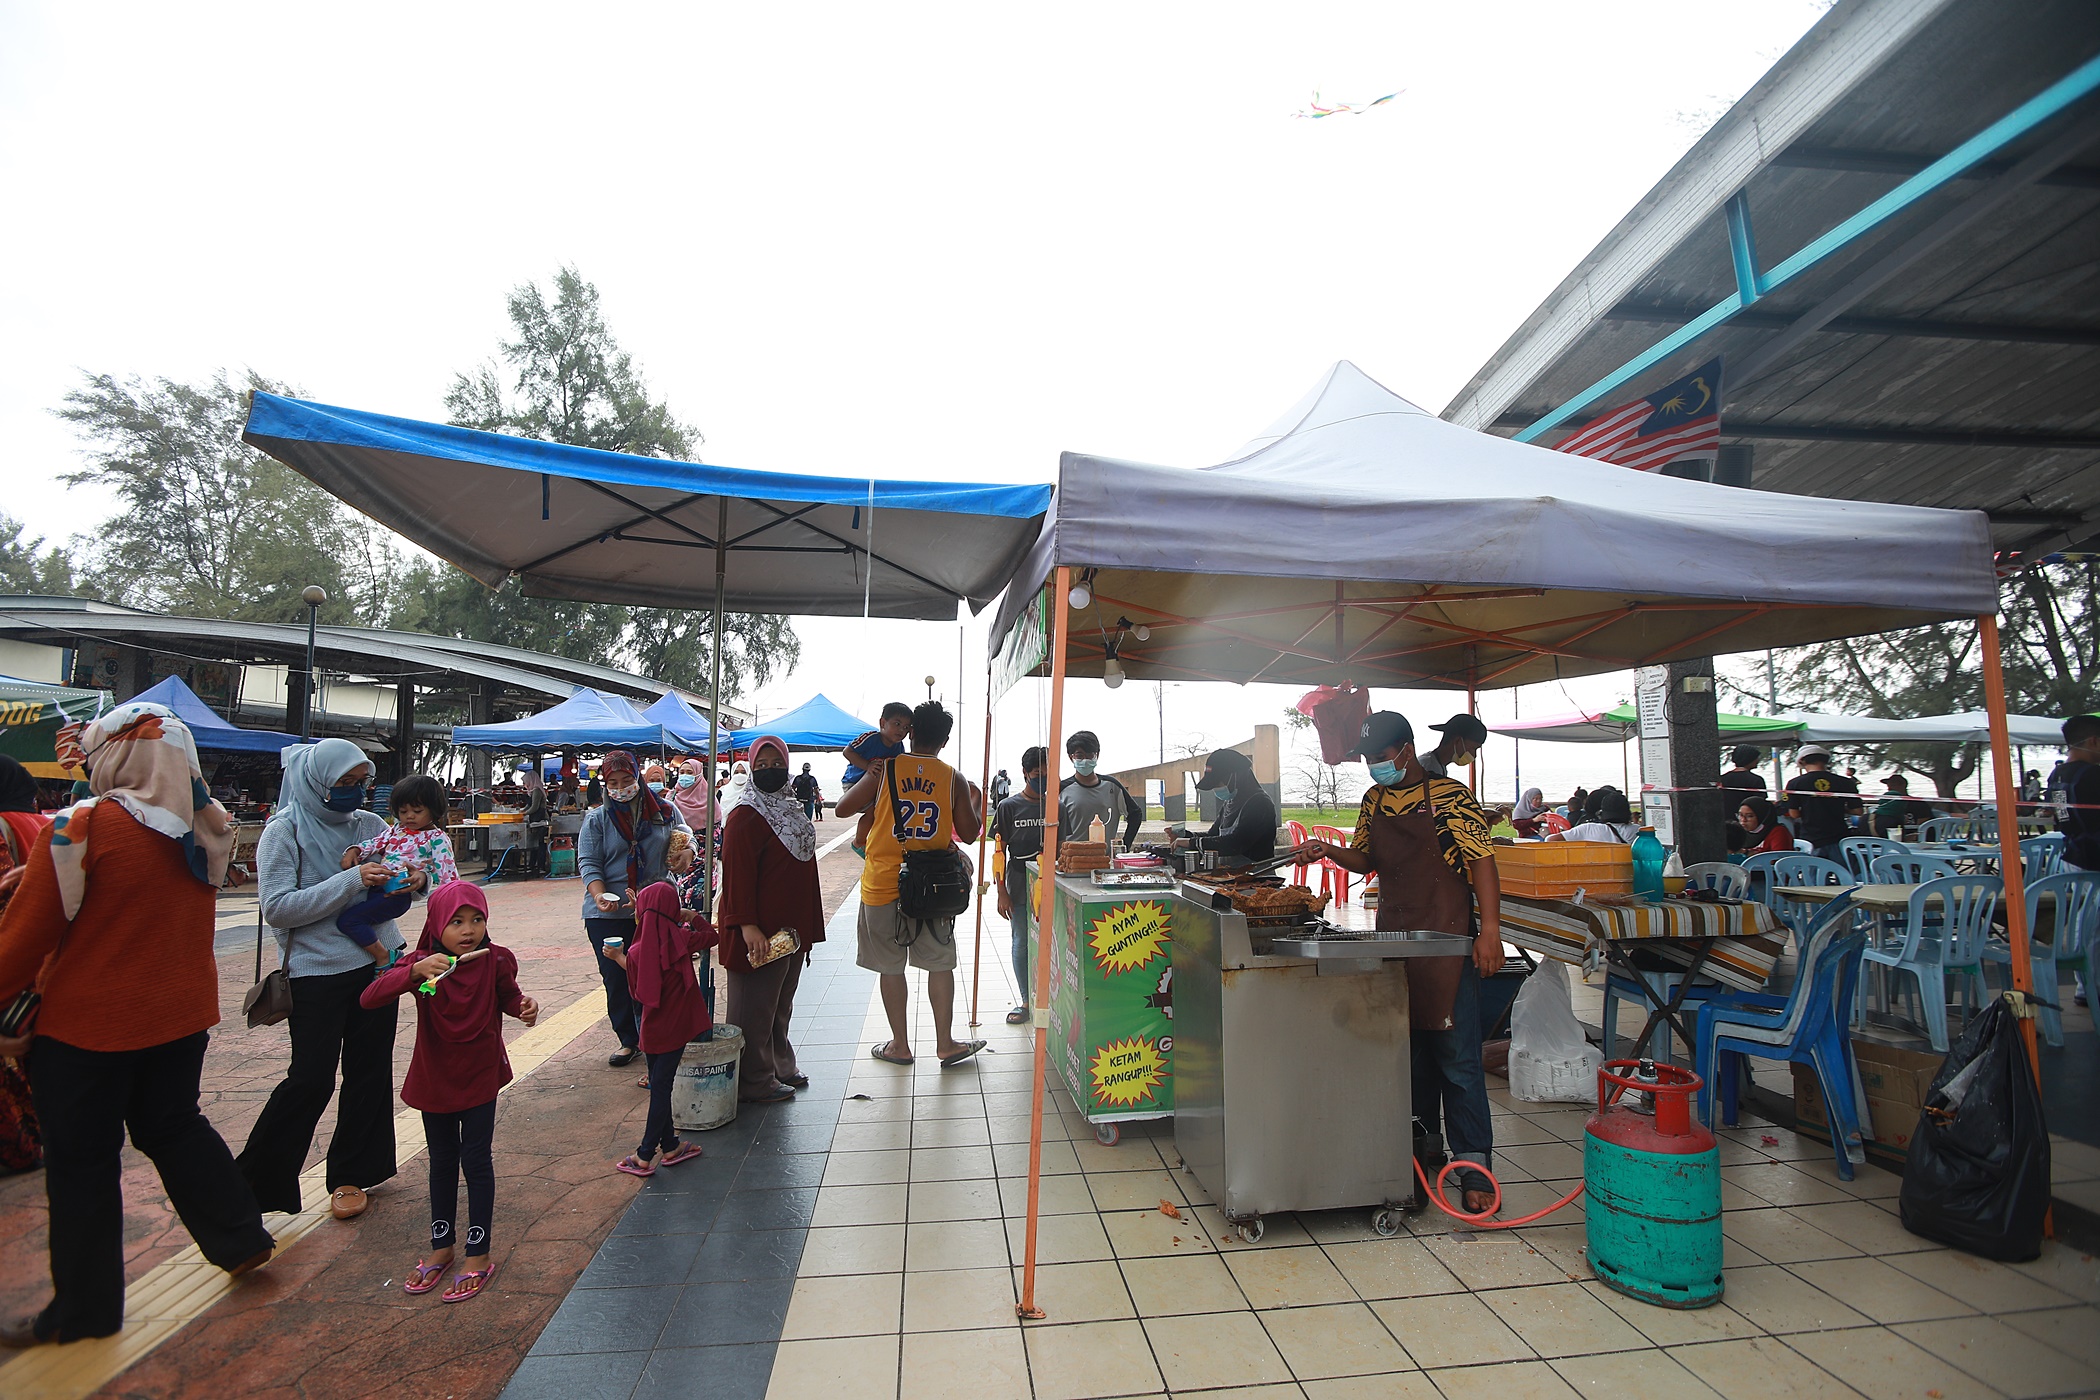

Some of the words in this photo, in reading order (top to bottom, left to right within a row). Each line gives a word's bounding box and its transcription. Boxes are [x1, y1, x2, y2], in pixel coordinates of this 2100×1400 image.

[901, 777, 935, 795] JAMES
[892, 799, 940, 840] 23
[1014, 818, 1046, 828] CONVE
[1112, 913, 1140, 935] AYAM
[1107, 920, 1160, 956] GUNTING!!!
[1109, 1051, 1141, 1067] KETAM
[704, 1065, 728, 1076] PAINT
[1104, 1064, 1153, 1087] RANGUP!!!
